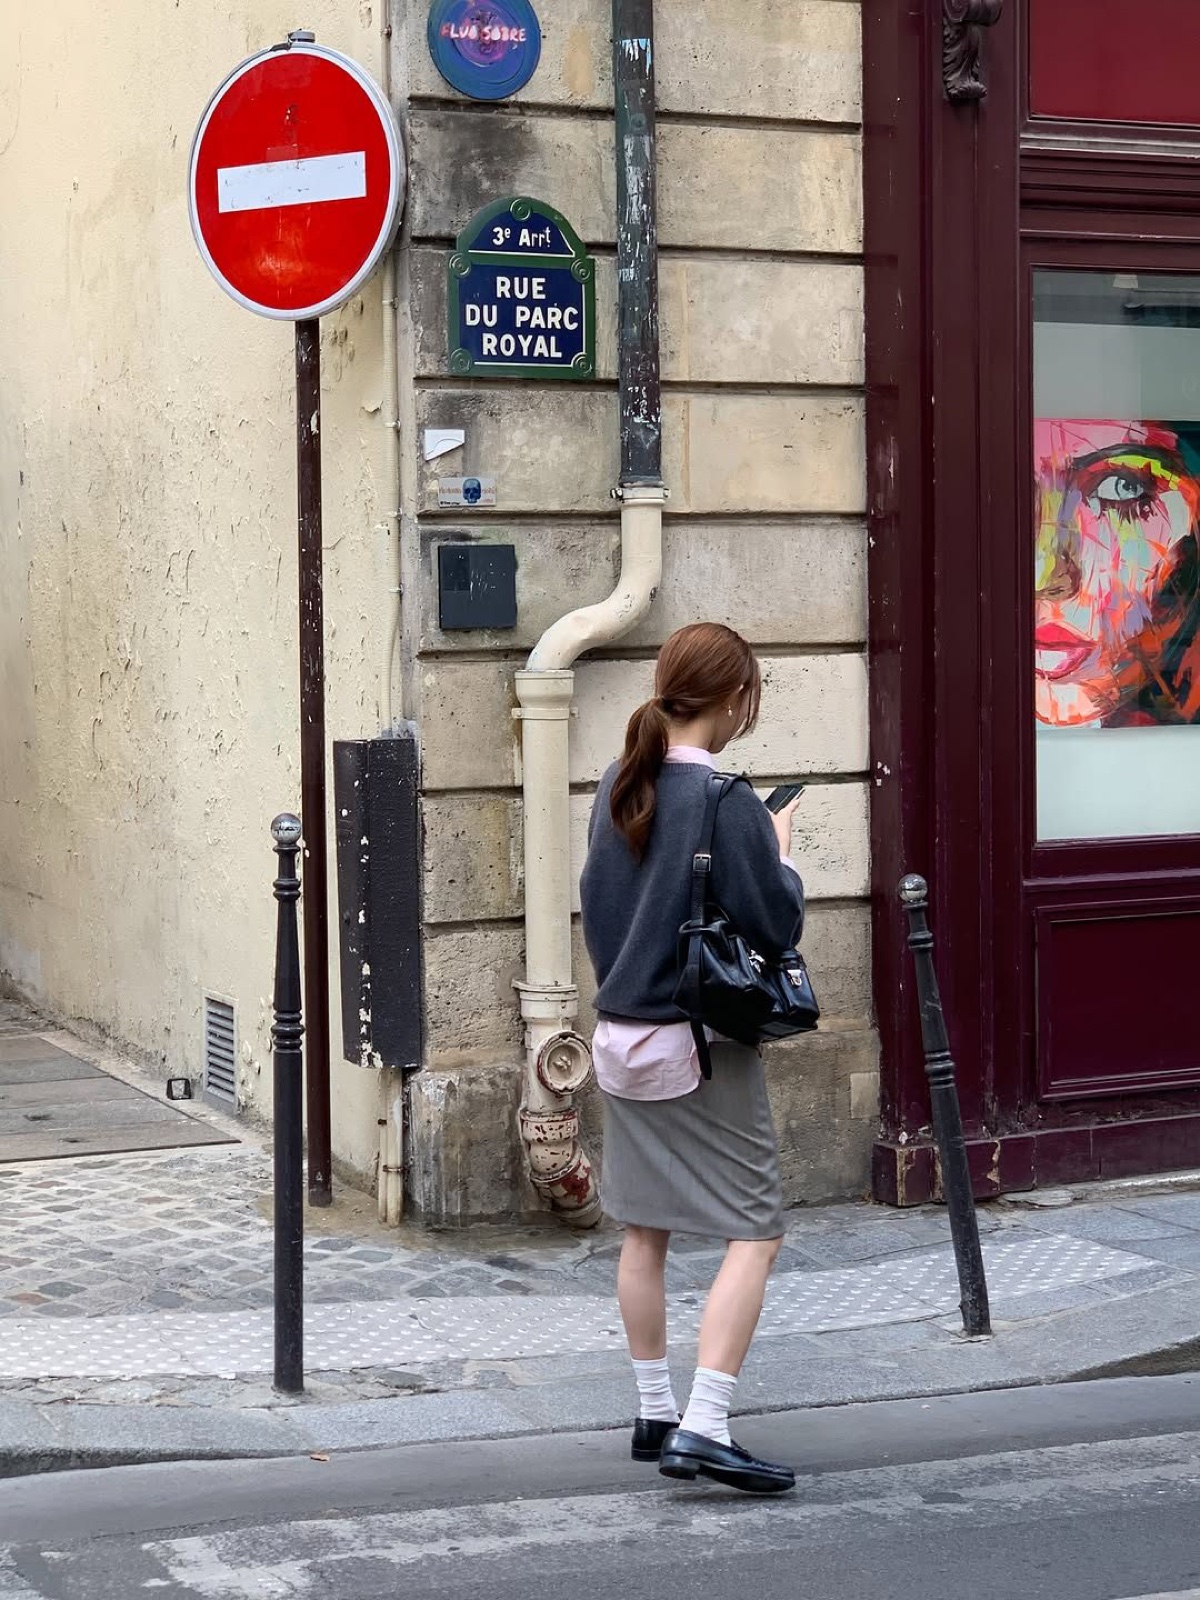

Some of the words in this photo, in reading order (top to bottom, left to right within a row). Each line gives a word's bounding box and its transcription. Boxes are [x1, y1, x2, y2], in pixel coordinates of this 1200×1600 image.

[496, 277, 546, 299] RUE
[466, 304, 498, 326] DU
[516, 306, 578, 330] PARC
[482, 333, 562, 357] ROYAL
